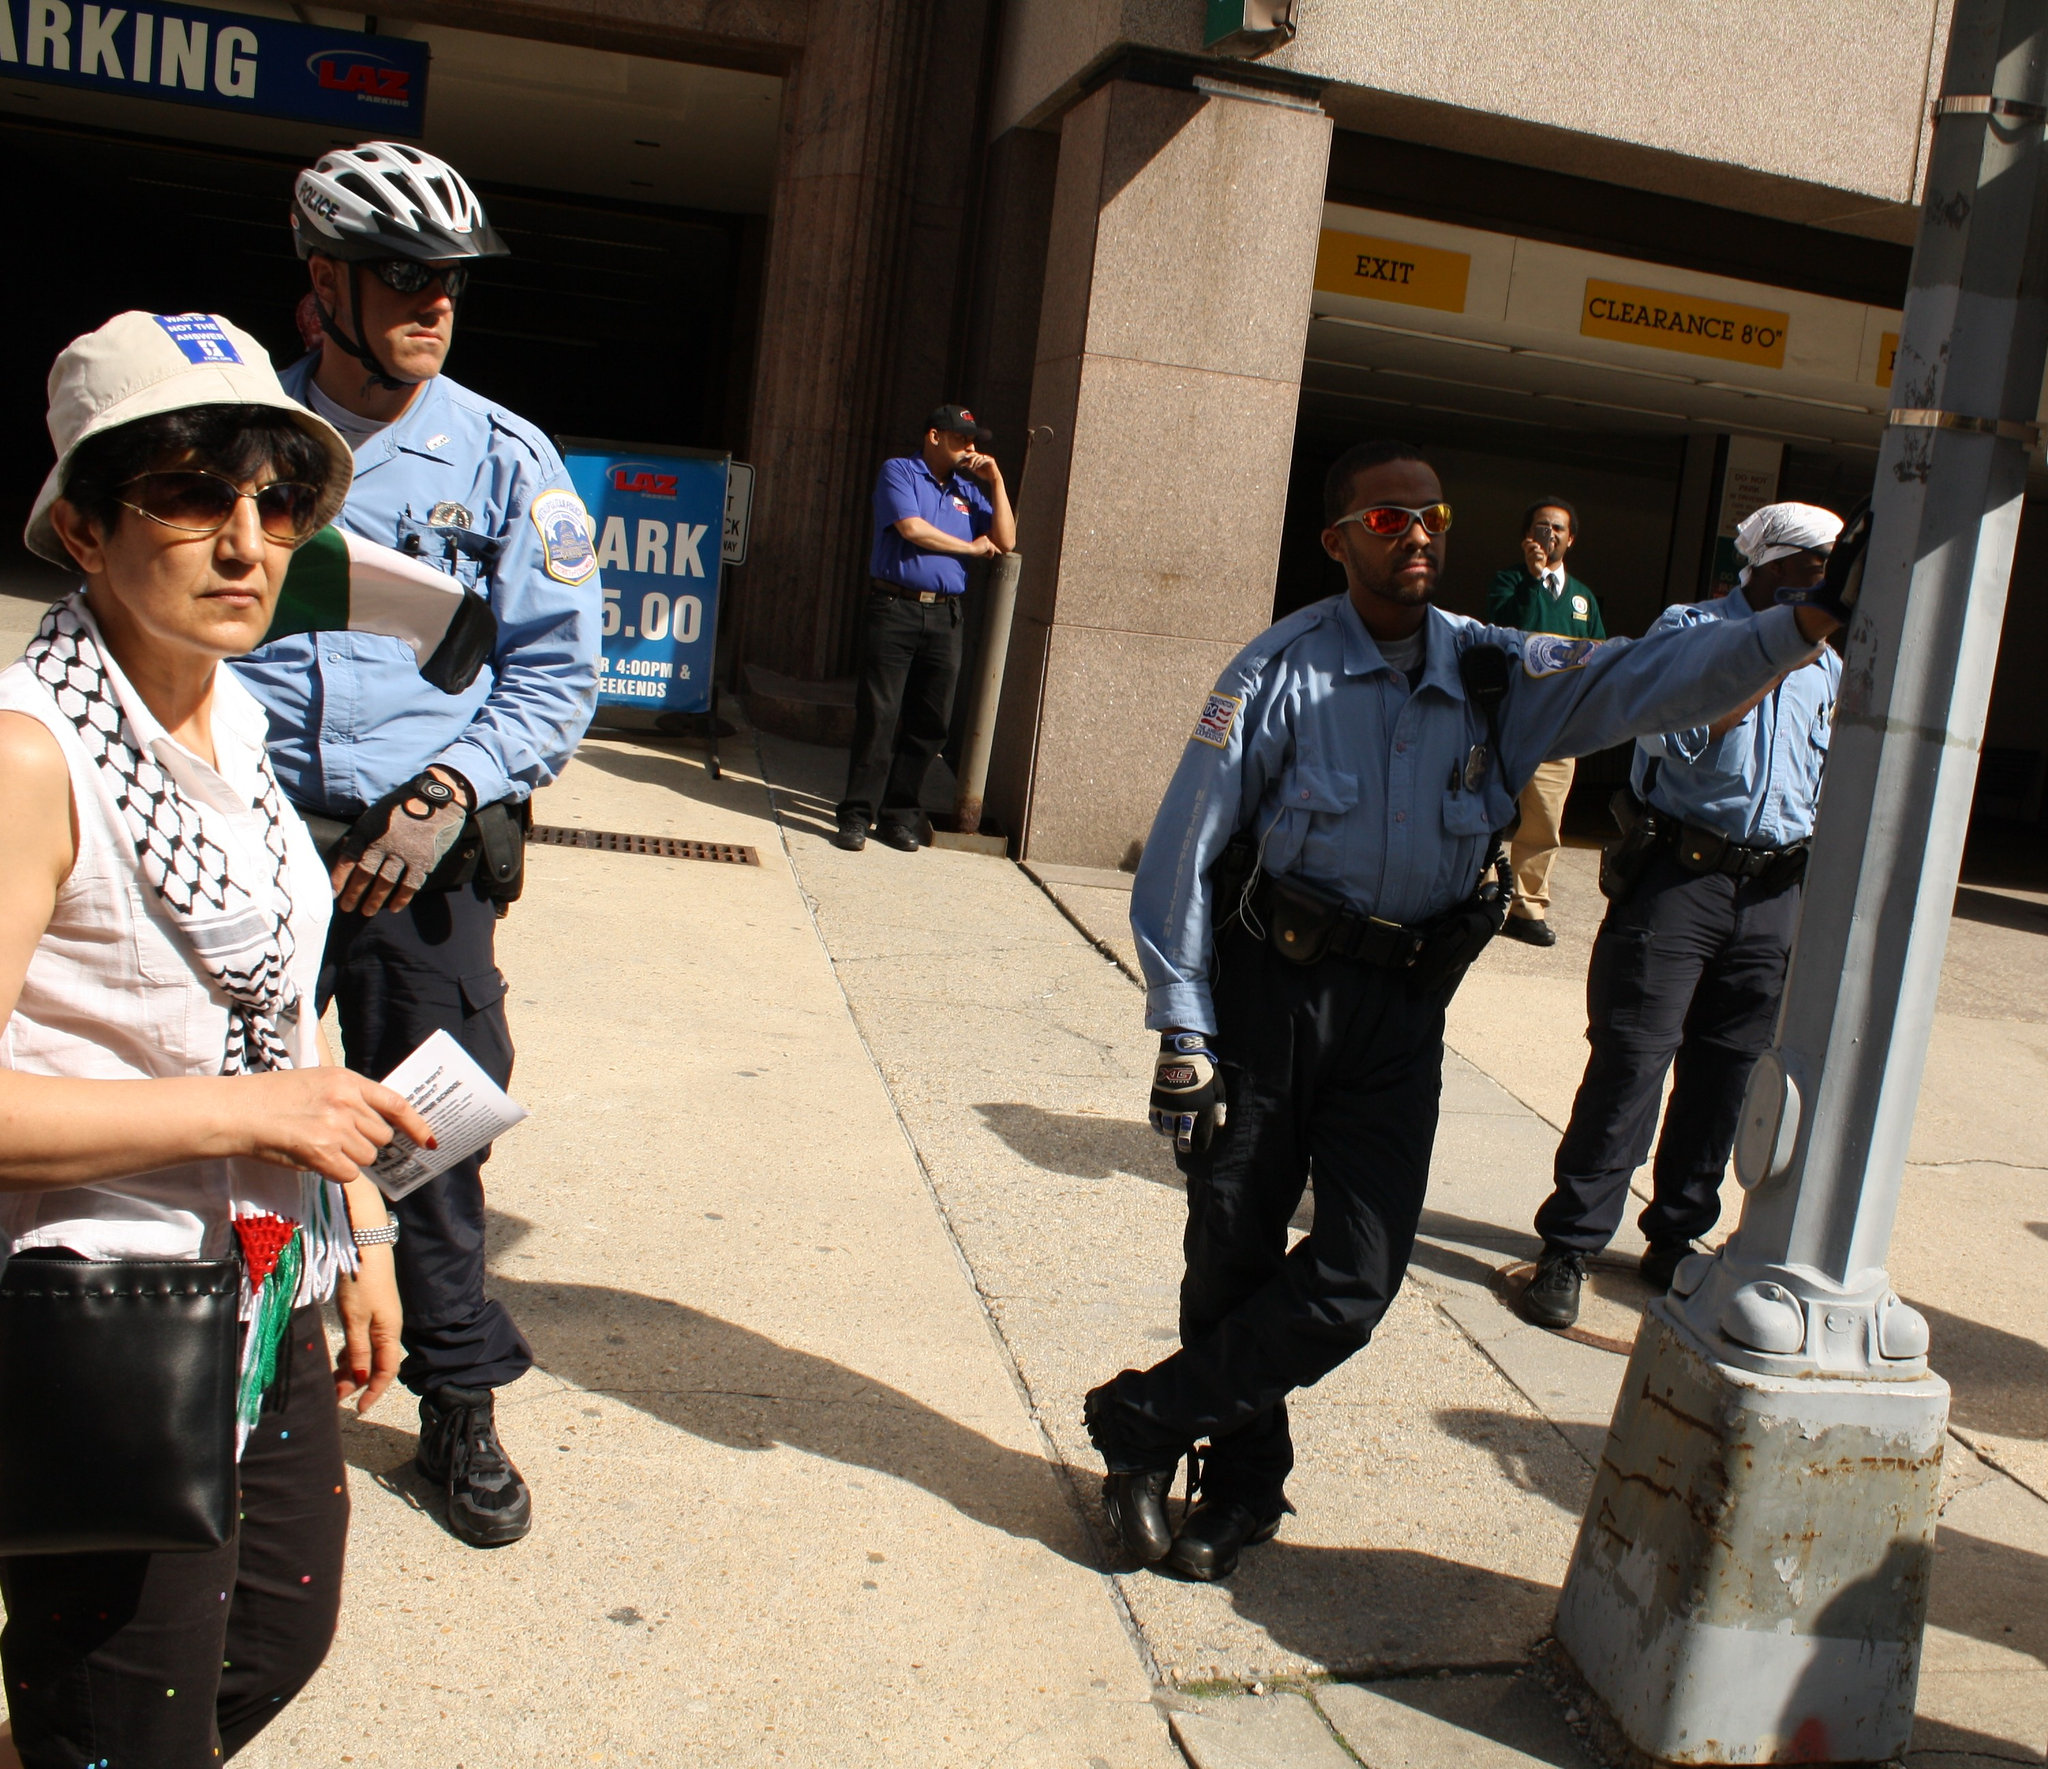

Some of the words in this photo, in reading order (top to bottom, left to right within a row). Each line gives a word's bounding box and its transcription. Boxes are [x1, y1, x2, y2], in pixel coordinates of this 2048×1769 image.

[319, 60, 410, 98] LAZ
[357, 94, 409, 107] PARKING
[299, 181, 341, 223] POLICE
[1354, 255, 1414, 284] EXIT
[167, 323, 192, 332] NOT
[194, 322, 219, 330] THE
[1589, 298, 1735, 341] CLEARANCE
[177, 332, 227, 341] ANSWER
[615, 470, 678, 496] LAZ
[616, 659, 673, 679] 4:00PM
[680, 664, 690, 680] &
[599, 676, 667, 698] EEKENDS
[413, 1083, 426, 1094] the
